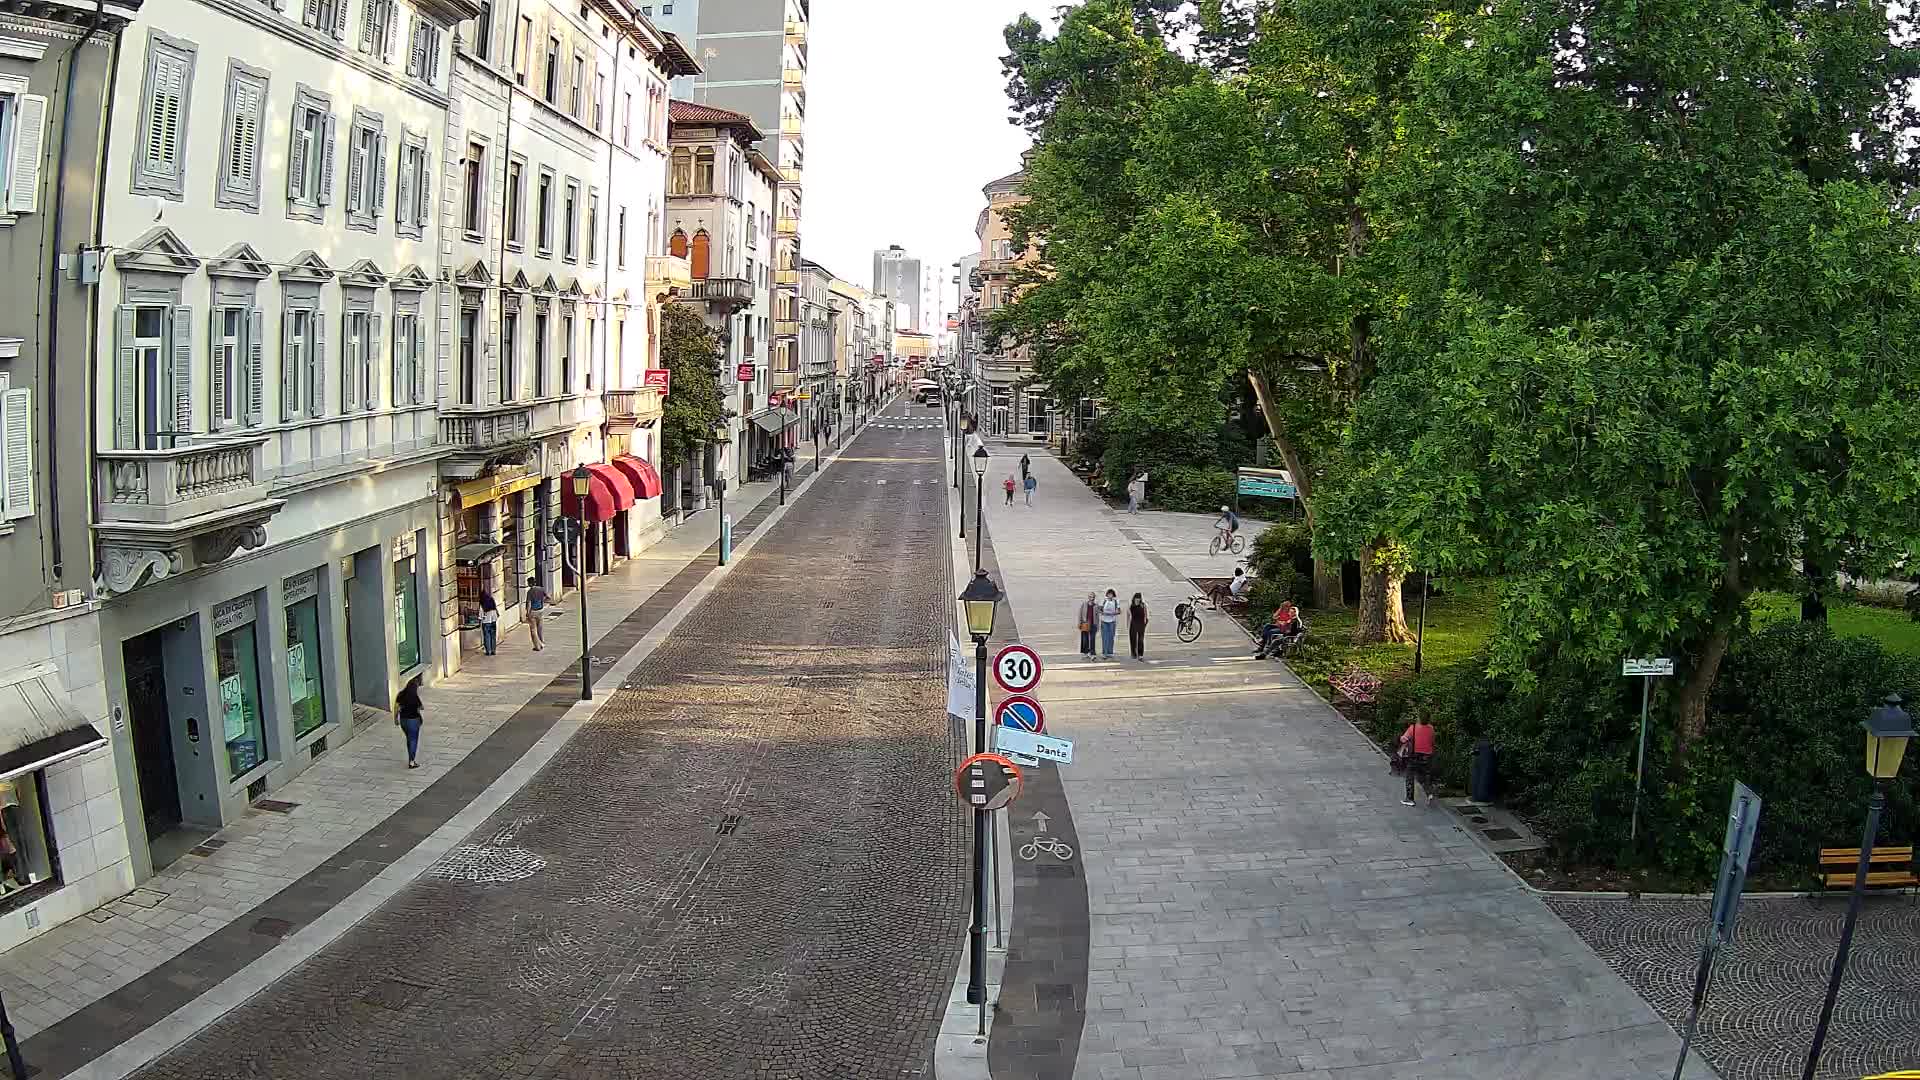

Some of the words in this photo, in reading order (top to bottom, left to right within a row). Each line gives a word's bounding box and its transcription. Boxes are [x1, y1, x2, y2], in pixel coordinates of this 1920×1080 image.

[231, 597, 253, 612] CREDITO
[1004, 658, 1032, 680] 30
[1036, 744, 1067, 758] Dante
